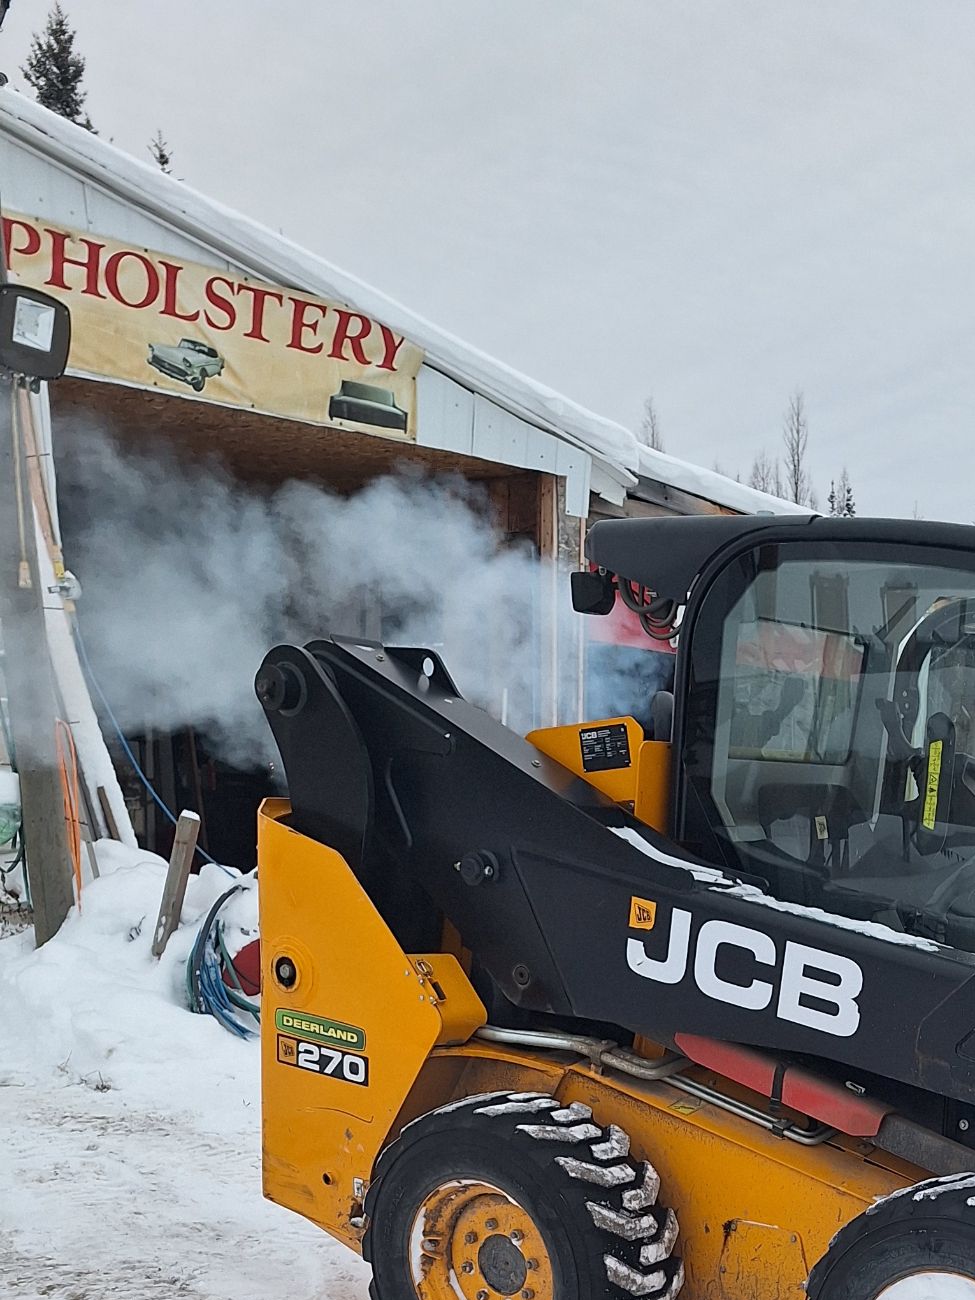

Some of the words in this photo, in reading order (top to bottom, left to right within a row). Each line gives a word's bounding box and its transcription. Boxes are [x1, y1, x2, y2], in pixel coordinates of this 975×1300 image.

[636, 904, 652, 922] JCB
[626, 907, 864, 1037] JCB
[282, 1015, 359, 1044] DEERLAND
[297, 1041, 367, 1083] 270
